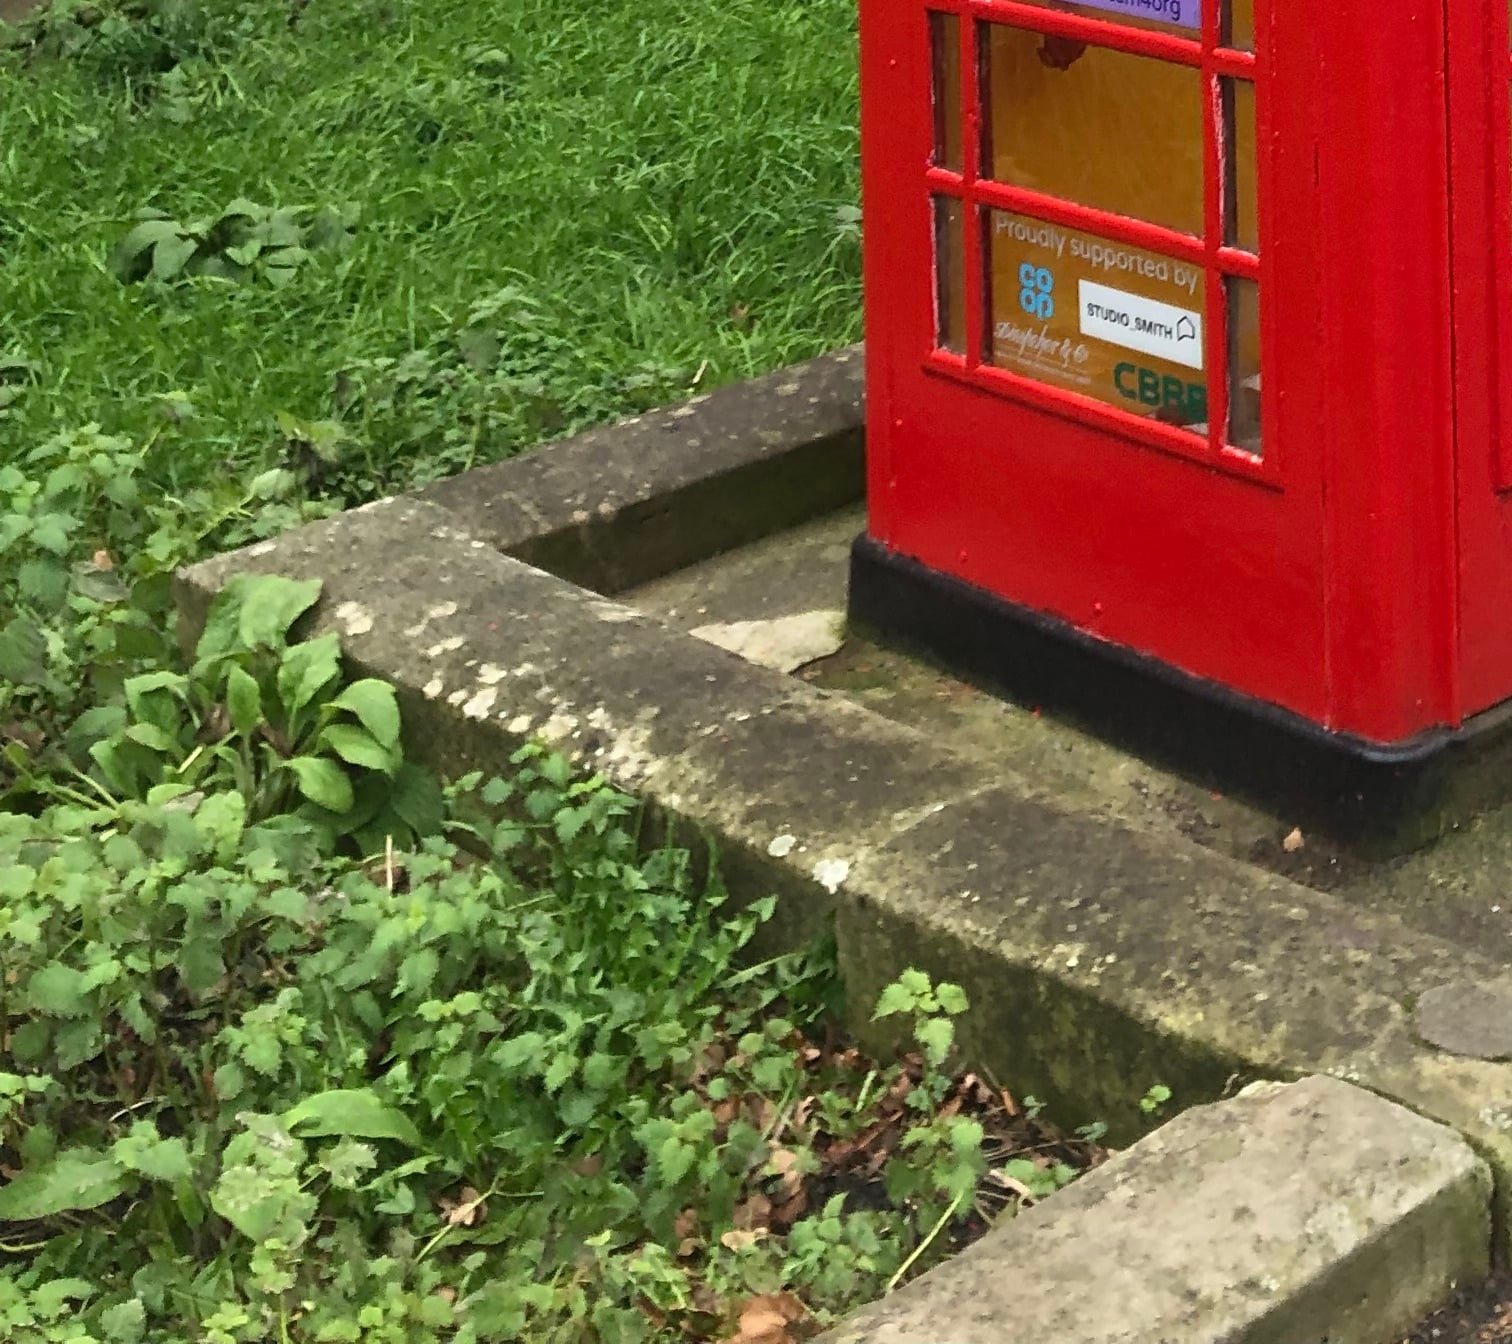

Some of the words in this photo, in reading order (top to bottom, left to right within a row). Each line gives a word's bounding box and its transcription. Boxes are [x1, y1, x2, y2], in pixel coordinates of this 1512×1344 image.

[996, 216, 1066, 257] Proudly
[1070, 237, 1169, 282] supported
[1173, 263, 1199, 296] by
